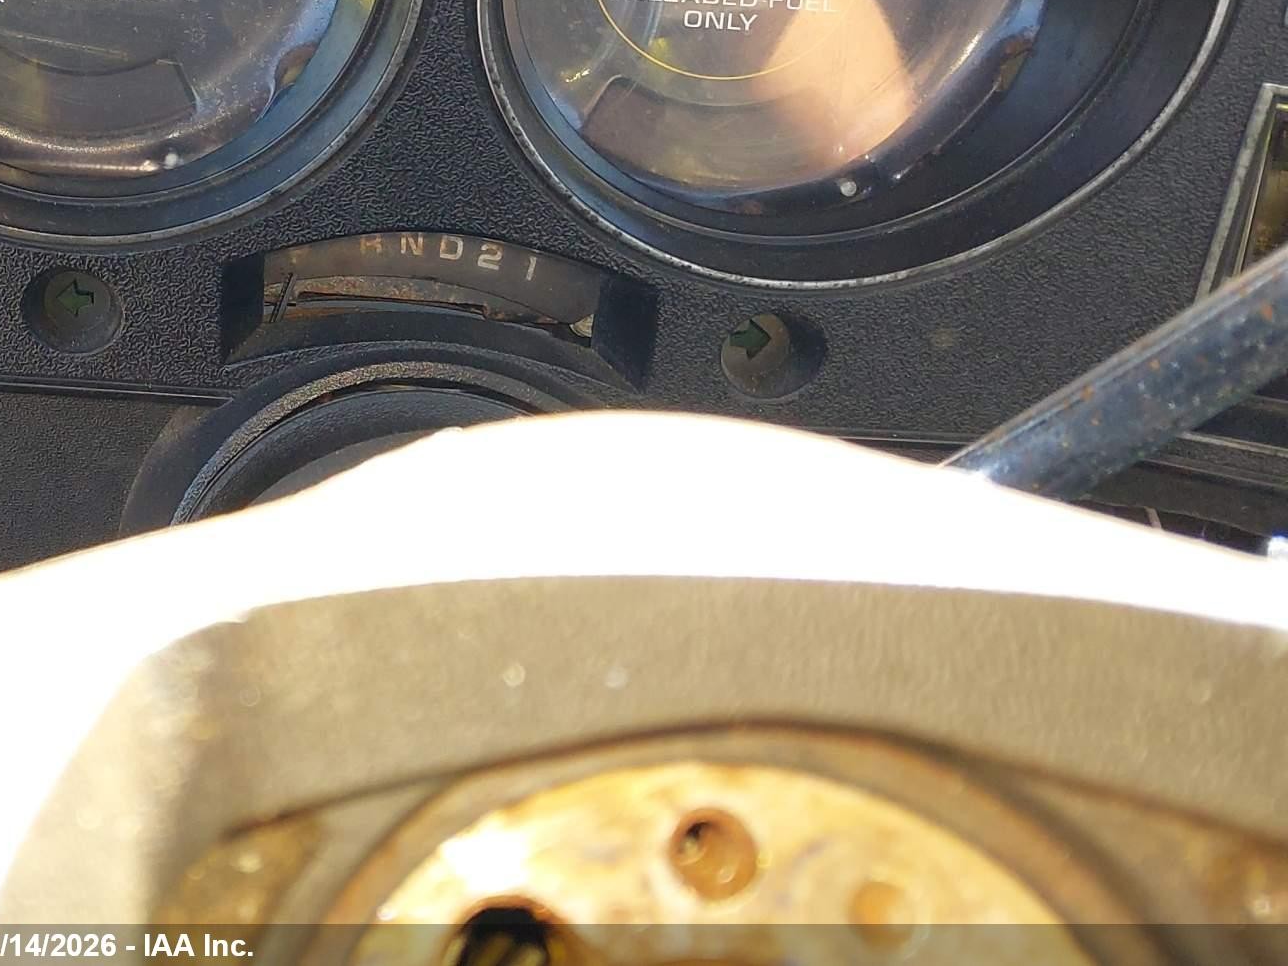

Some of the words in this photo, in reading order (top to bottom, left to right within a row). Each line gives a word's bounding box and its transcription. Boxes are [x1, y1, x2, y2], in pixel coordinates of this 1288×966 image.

[683, 10, 758, 31] ONLY
[400, 234, 424, 255] N
[439, 236, 464, 260] D
[477, 242, 504, 270] 2
